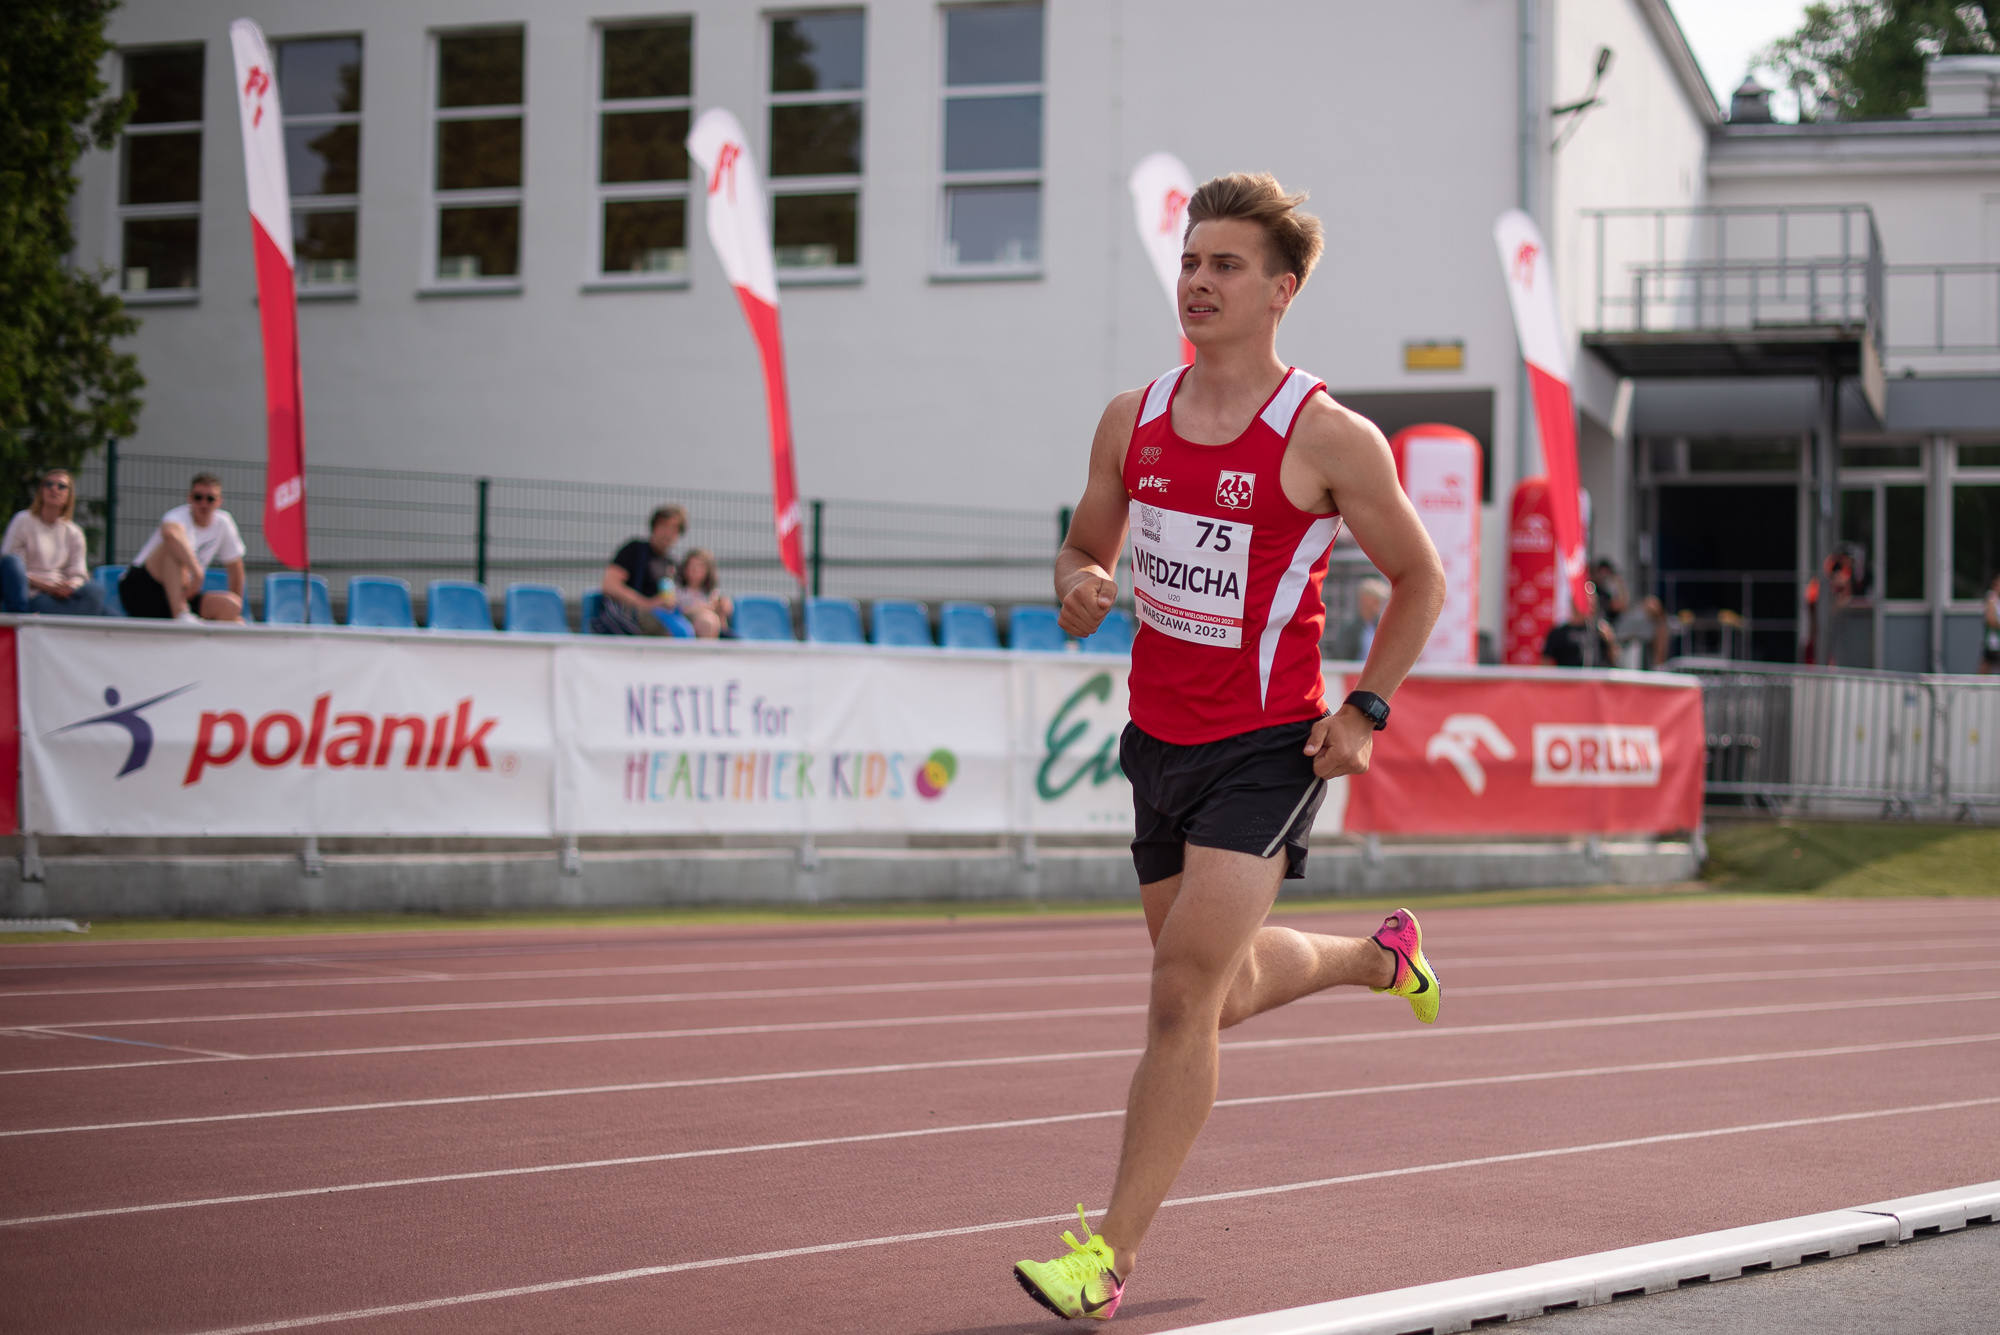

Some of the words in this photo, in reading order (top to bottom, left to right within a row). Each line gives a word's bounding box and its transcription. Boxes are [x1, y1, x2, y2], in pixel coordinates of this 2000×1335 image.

[1138, 475, 1163, 490] pts
[1196, 520, 1233, 552] 75
[1135, 546, 1240, 600] WĘDZICHA
[1167, 593, 1181, 603] U20
[1141, 602, 1192, 634] WARSZAWA
[1194, 624, 1227, 639] 2023
[1220, 618, 1235, 626] 2023
[751, 694, 793, 737] for
[624, 750, 816, 804] HEALTHIER
[830, 751, 905, 800] KIDS
